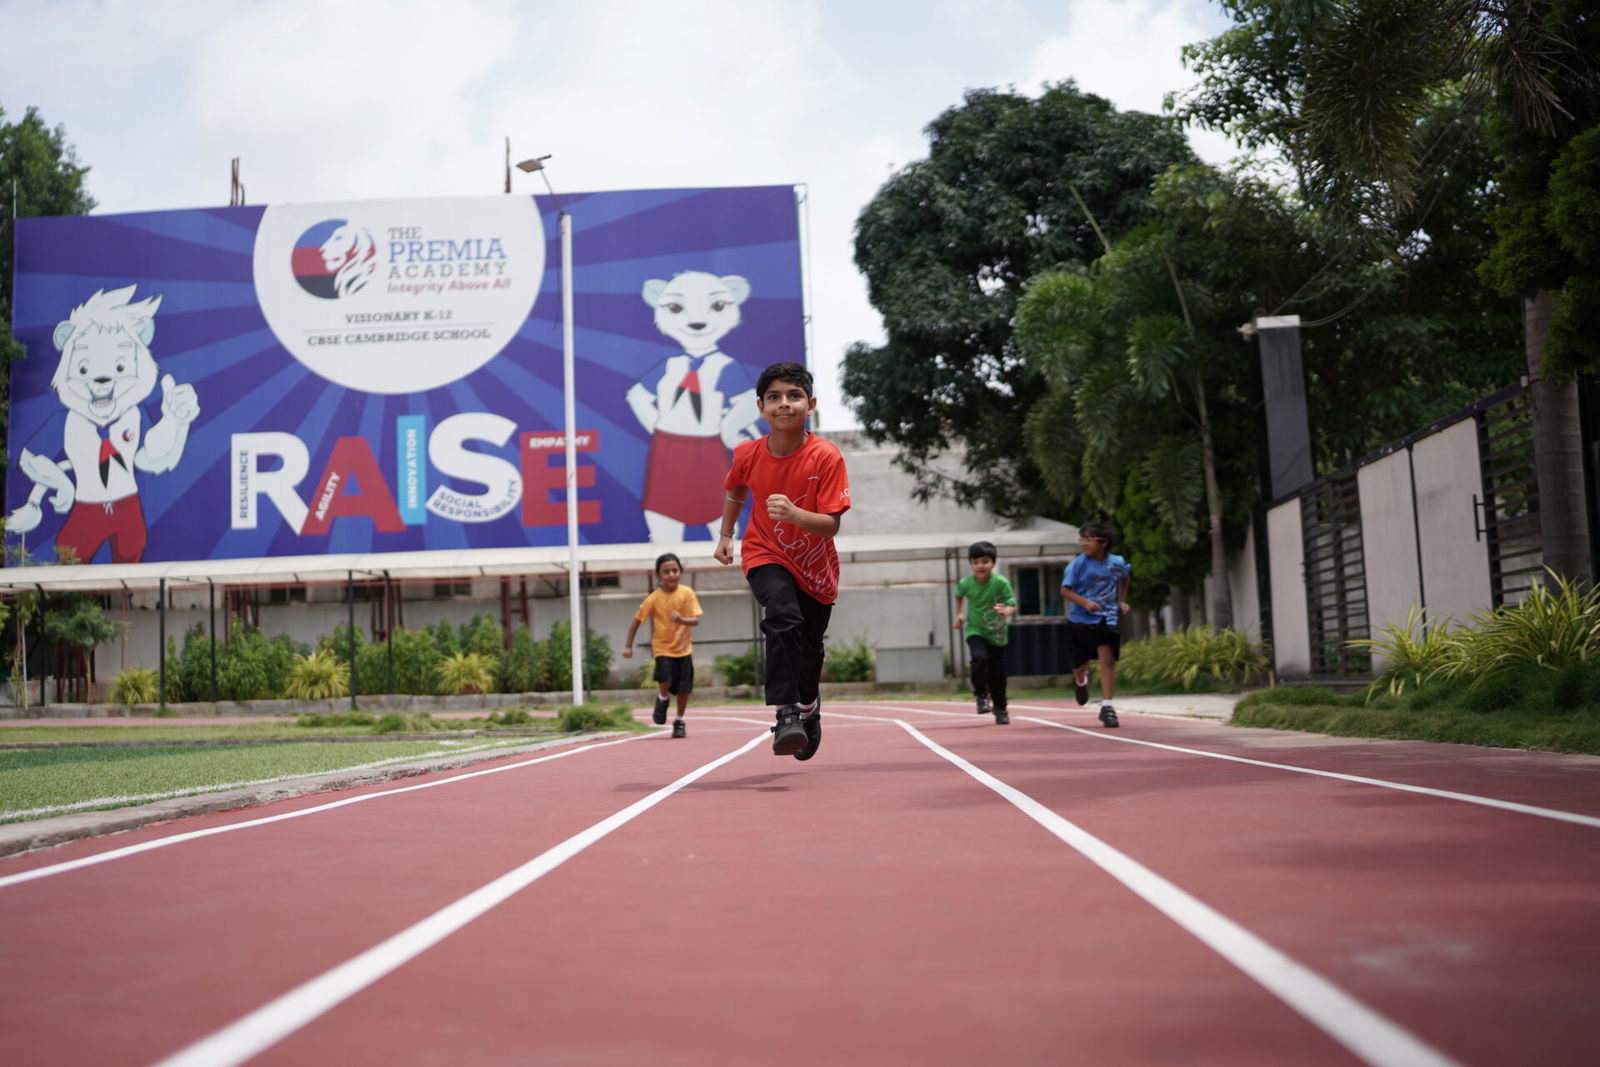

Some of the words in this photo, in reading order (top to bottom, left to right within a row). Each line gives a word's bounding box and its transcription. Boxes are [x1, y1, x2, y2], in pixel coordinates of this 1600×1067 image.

[387, 226, 422, 240] THE
[388, 238, 507, 263] PREMIA
[388, 261, 506, 279] ACADEMY
[387, 281, 444, 295] Integrity
[448, 279, 489, 291] Above
[492, 278, 511, 290] All
[345, 311, 420, 323] VISIONARY
[424, 309, 453, 321] K-12
[307, 334, 342, 346] CBSE
[345, 331, 430, 344] CAMBRIDGE
[434, 328, 491, 341] SCHOOL
[529, 435, 591, 449] EMPAHY
[231, 412, 602, 535] RAISE
[407, 429, 417, 509] INNOVATION
[239, 449, 249, 519] RESILIENCE
[315, 471, 340, 520] AGILITY
[432, 479, 518, 518] RESPONSIBILITY
[439, 491, 482, 508] SOCIAL
